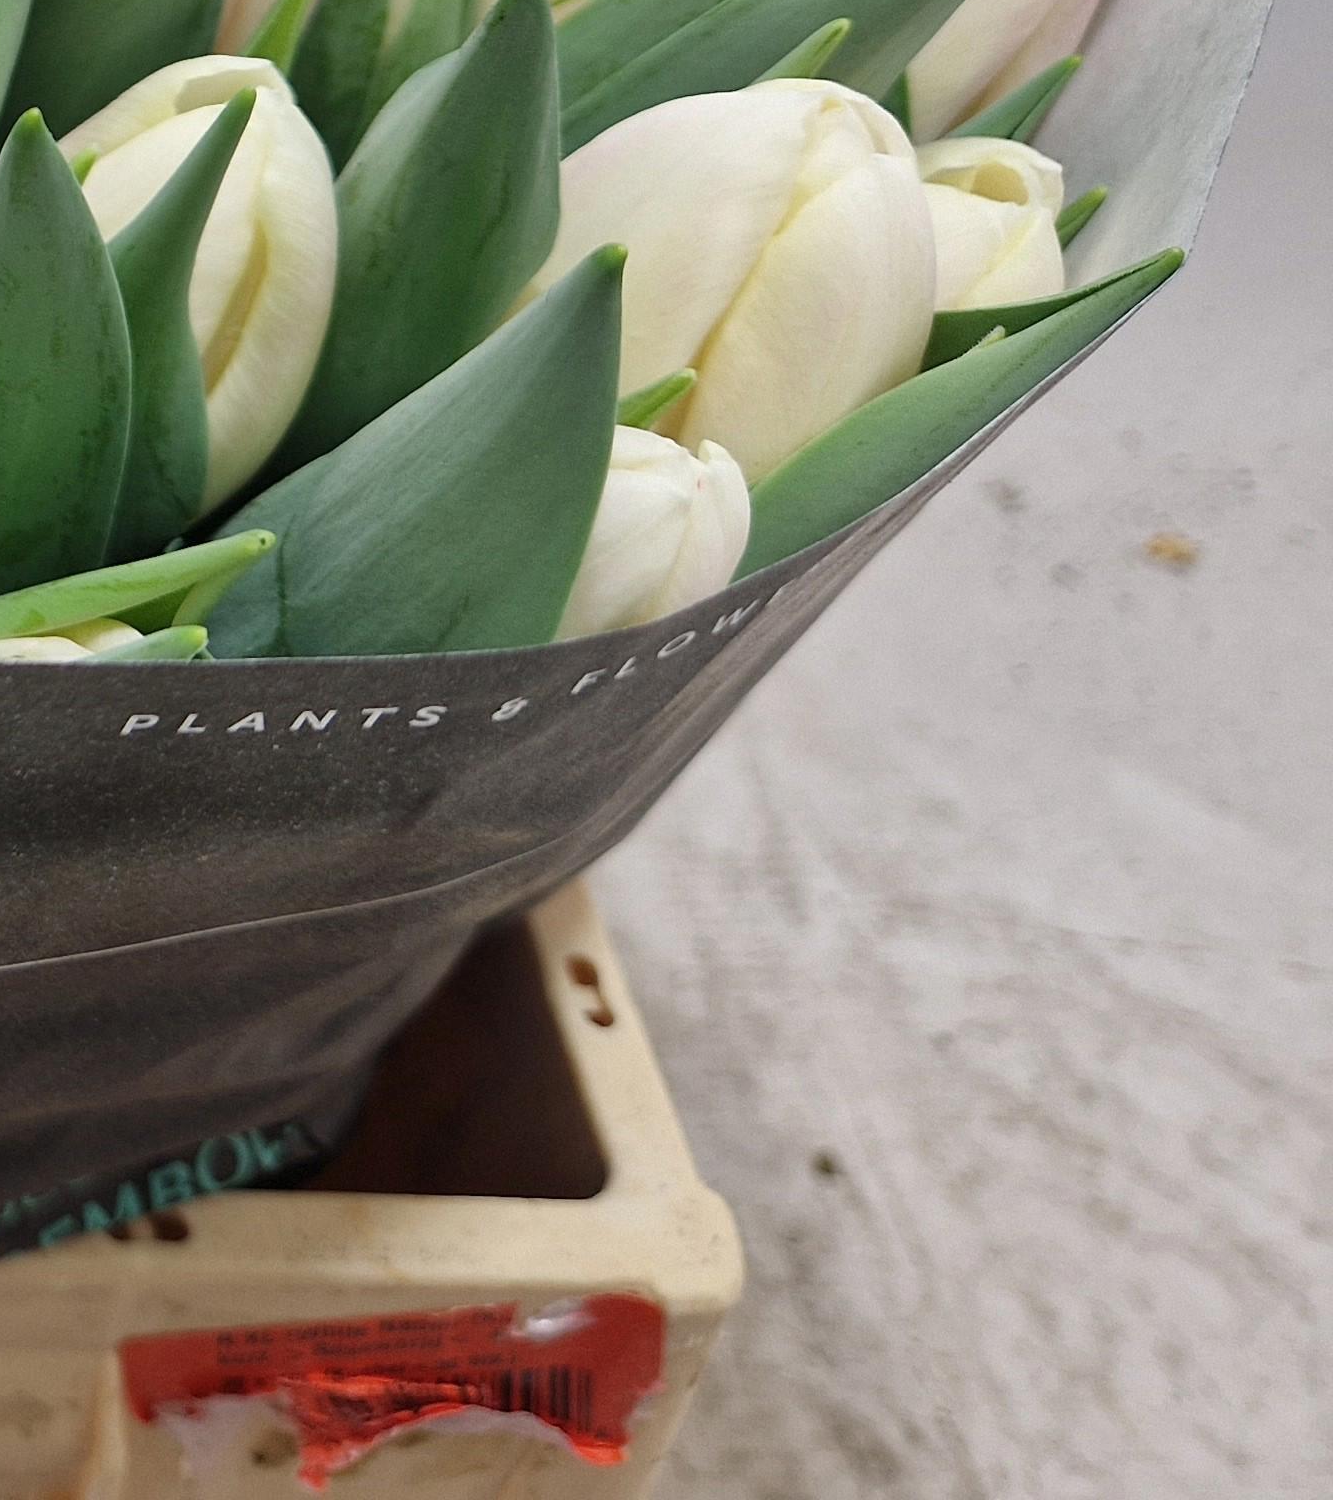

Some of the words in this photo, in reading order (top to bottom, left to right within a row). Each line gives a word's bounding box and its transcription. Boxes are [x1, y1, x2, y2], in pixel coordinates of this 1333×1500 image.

[118, 703, 449, 736] PLANTS
[490, 696, 530, 723] &
[569, 584, 783, 696] FLOW
